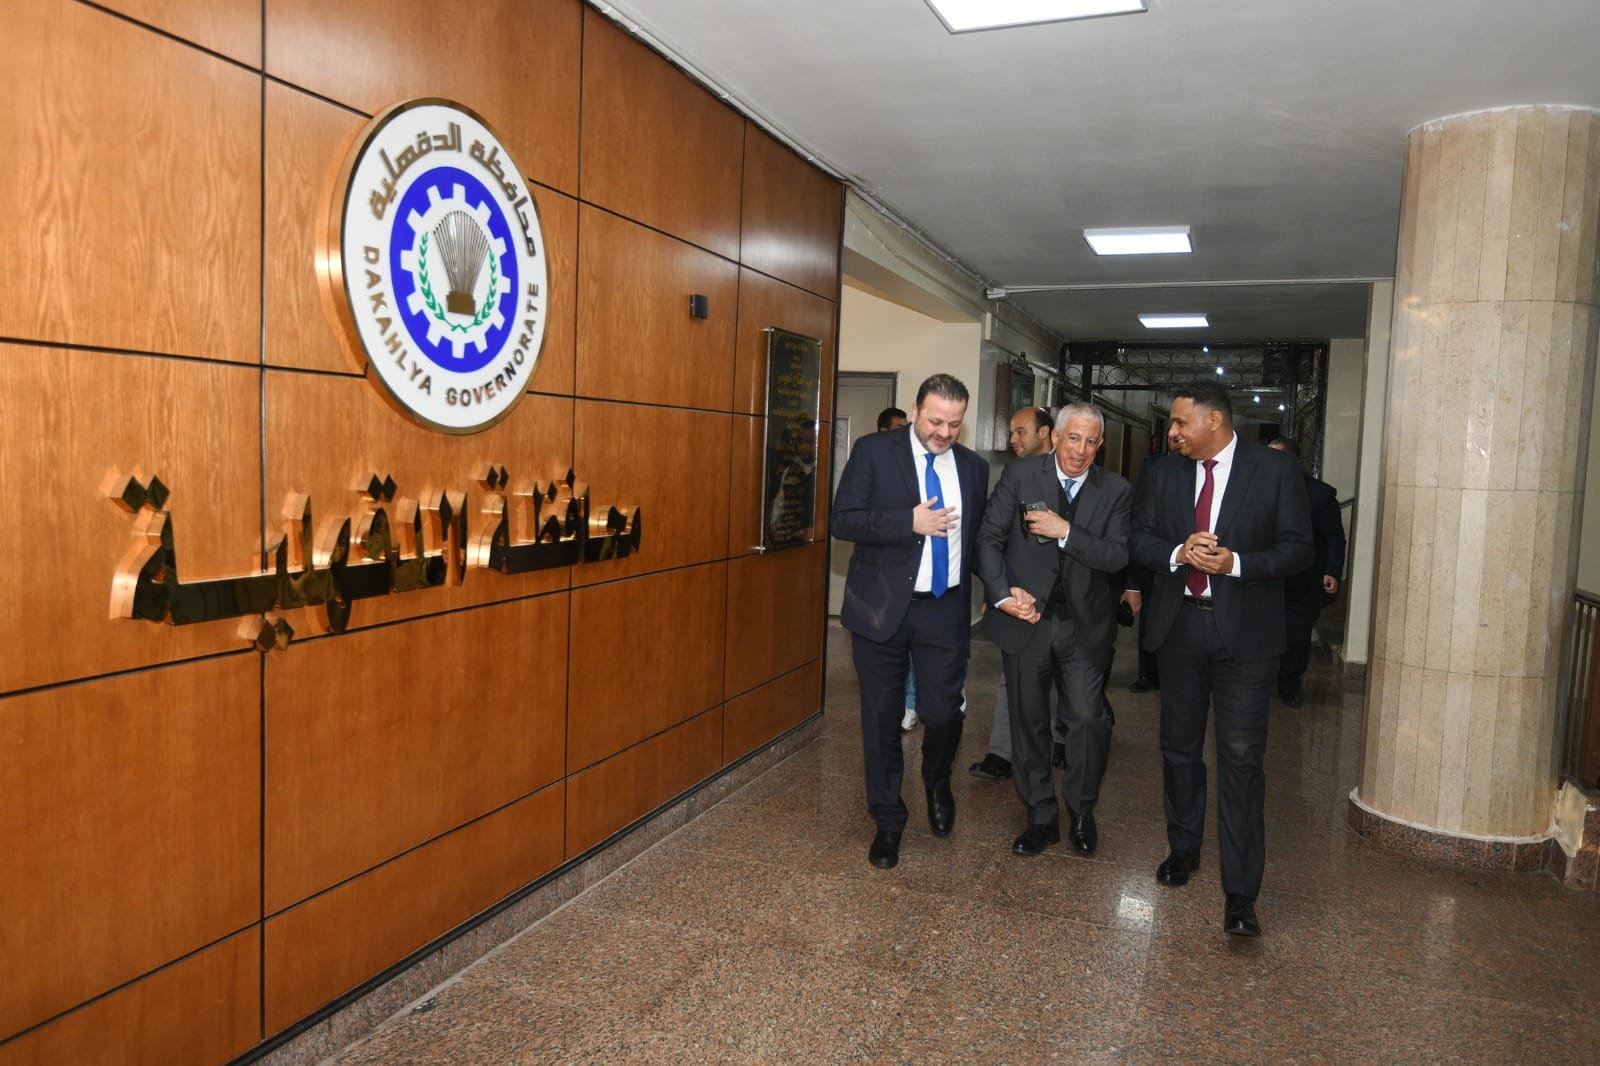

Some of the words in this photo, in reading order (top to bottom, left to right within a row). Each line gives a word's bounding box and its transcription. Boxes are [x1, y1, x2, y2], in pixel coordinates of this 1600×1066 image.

[368, 122, 462, 220] الدقهلية
[469, 139, 537, 257] محافظة
[363, 245, 432, 395] DAKAHLYA
[446, 282, 540, 407] GOVERNORATE
[109, 472, 468, 651] الدقهلية
[470, 466, 642, 575] محافظة
